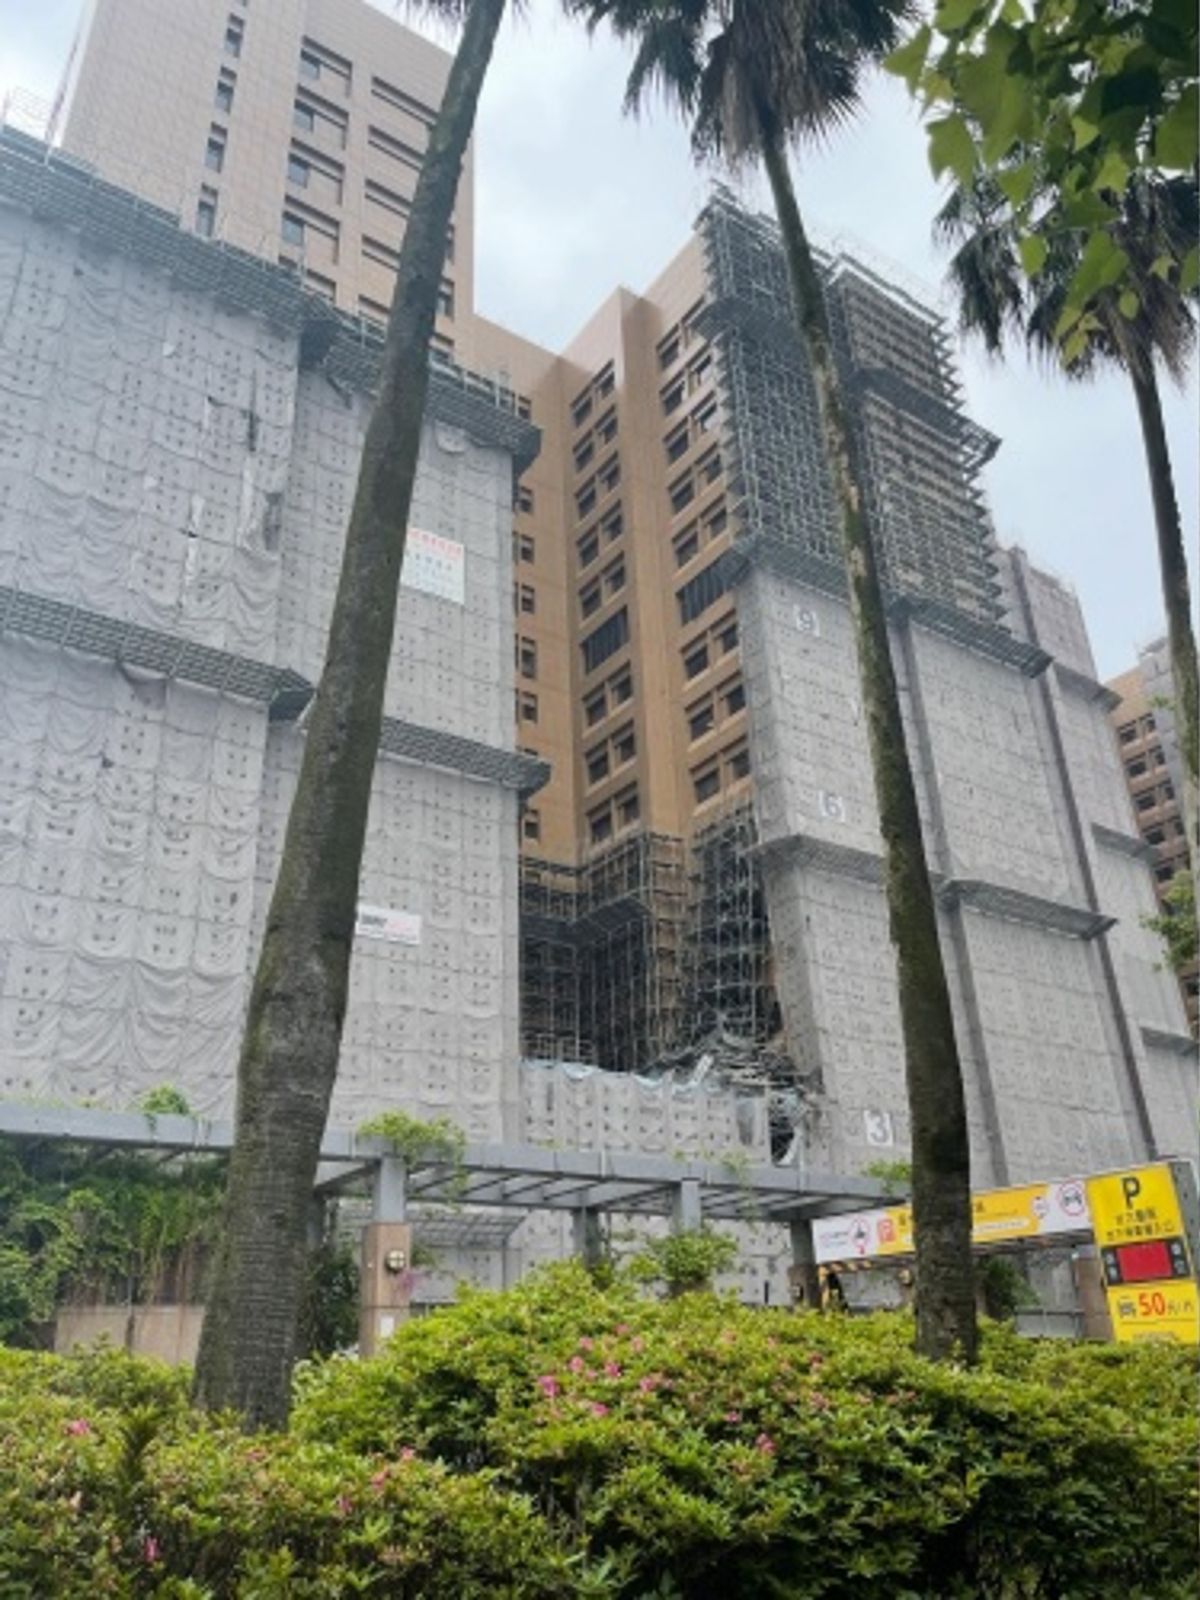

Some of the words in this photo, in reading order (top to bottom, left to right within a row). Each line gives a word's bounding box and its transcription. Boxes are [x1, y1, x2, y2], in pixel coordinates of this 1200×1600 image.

[799, 607, 816, 632] 9
[823, 791, 842, 817] 6
[867, 1109, 889, 1143] 3
[1122, 1177, 1140, 1209] P
[1138, 1292, 1165, 1316] 50
